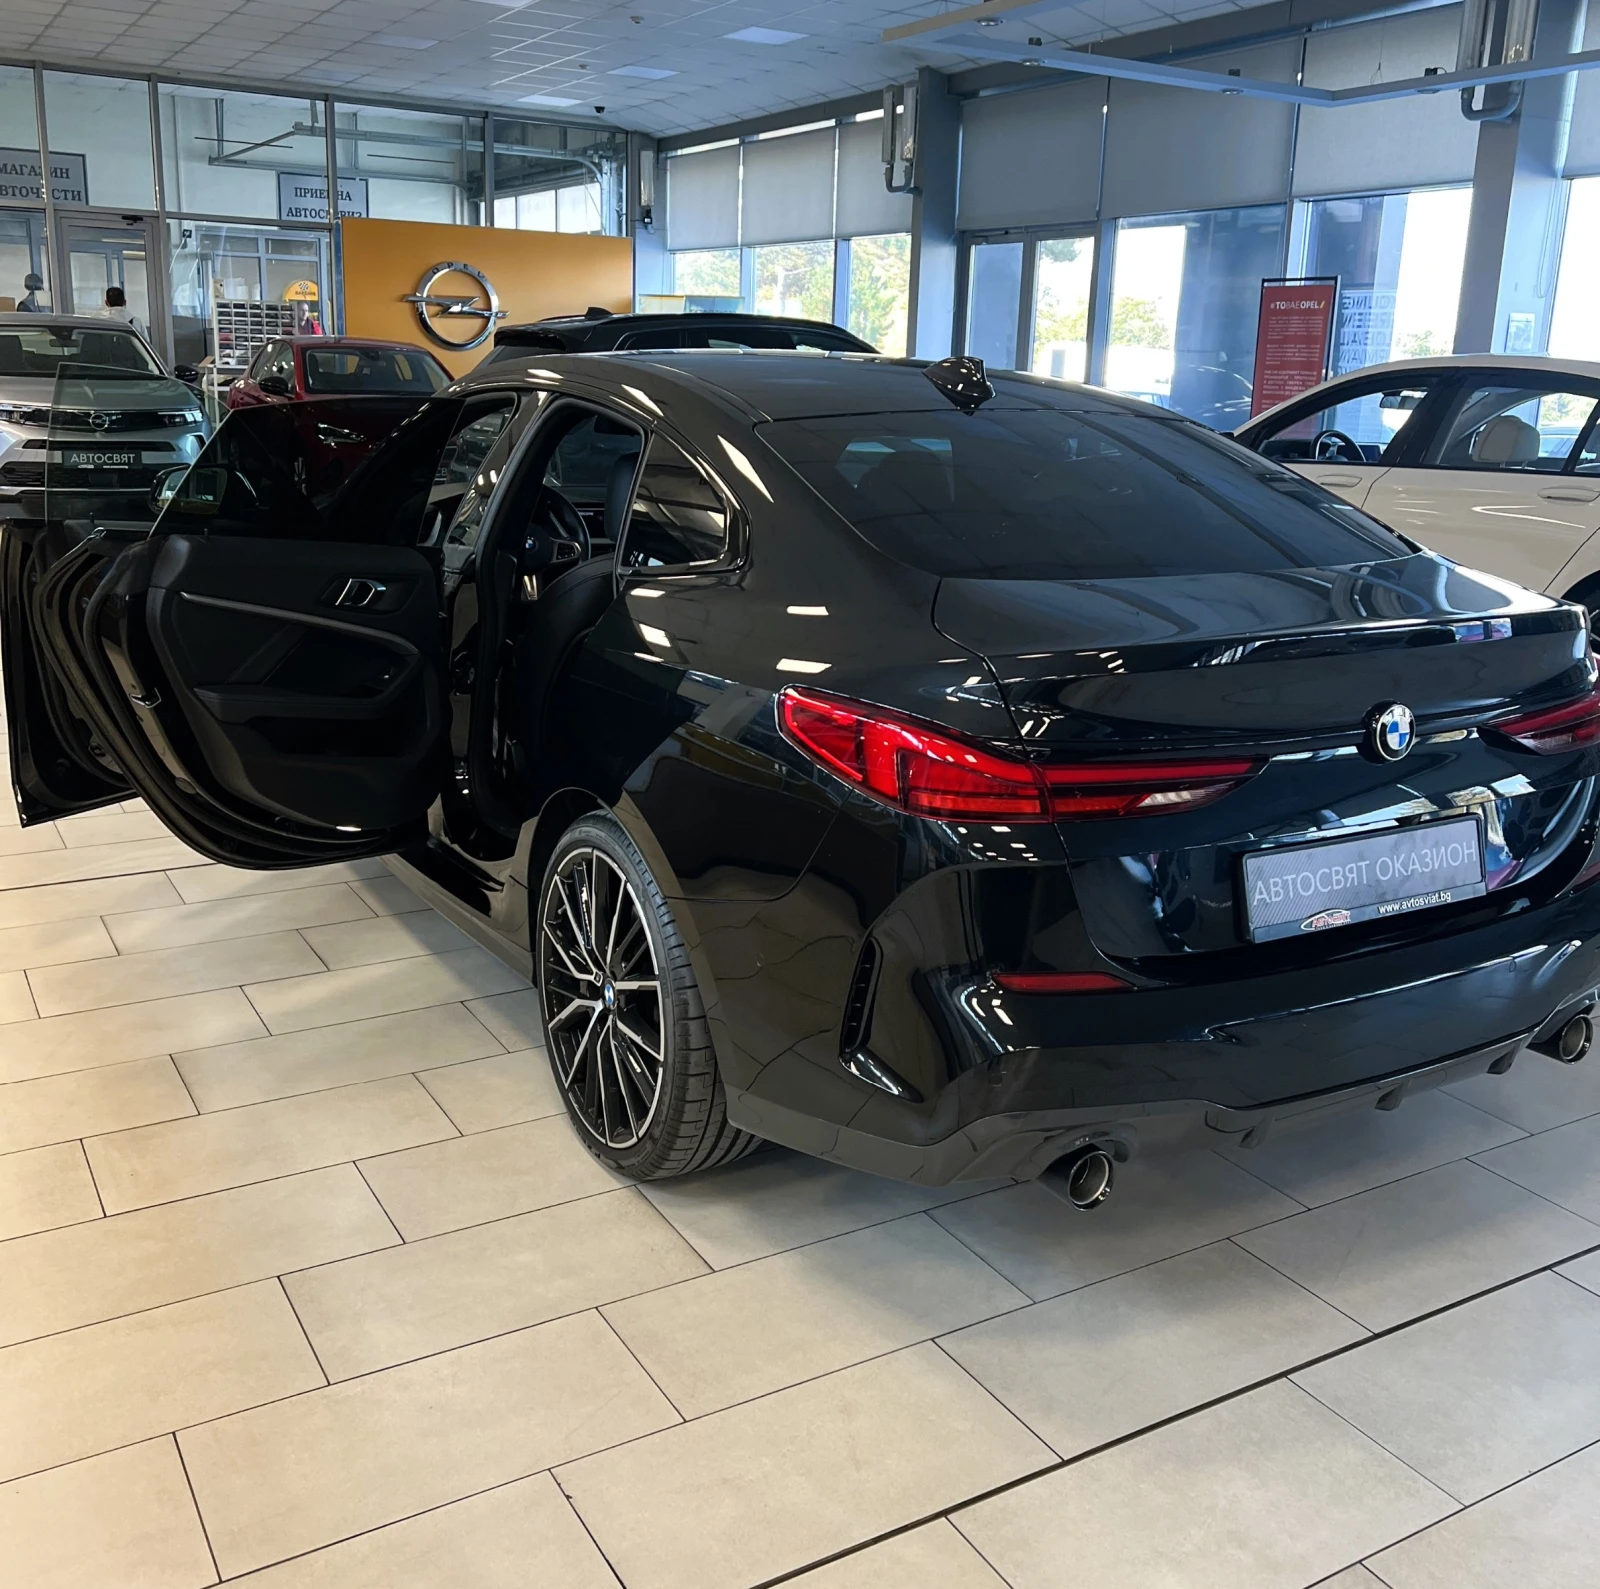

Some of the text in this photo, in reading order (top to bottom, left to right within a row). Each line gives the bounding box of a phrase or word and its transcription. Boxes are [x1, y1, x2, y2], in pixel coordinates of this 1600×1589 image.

[0, 185, 82, 201] ВТОЧСТИ
[292, 187, 352, 201] ПРИЕНА
[70, 453, 135, 464] АВТОСВЯТ
[1253, 840, 1477, 905] АВТОСВЯТ ОКАЗИОН
[1378, 891, 1451, 914] www.avtosviat.bg
